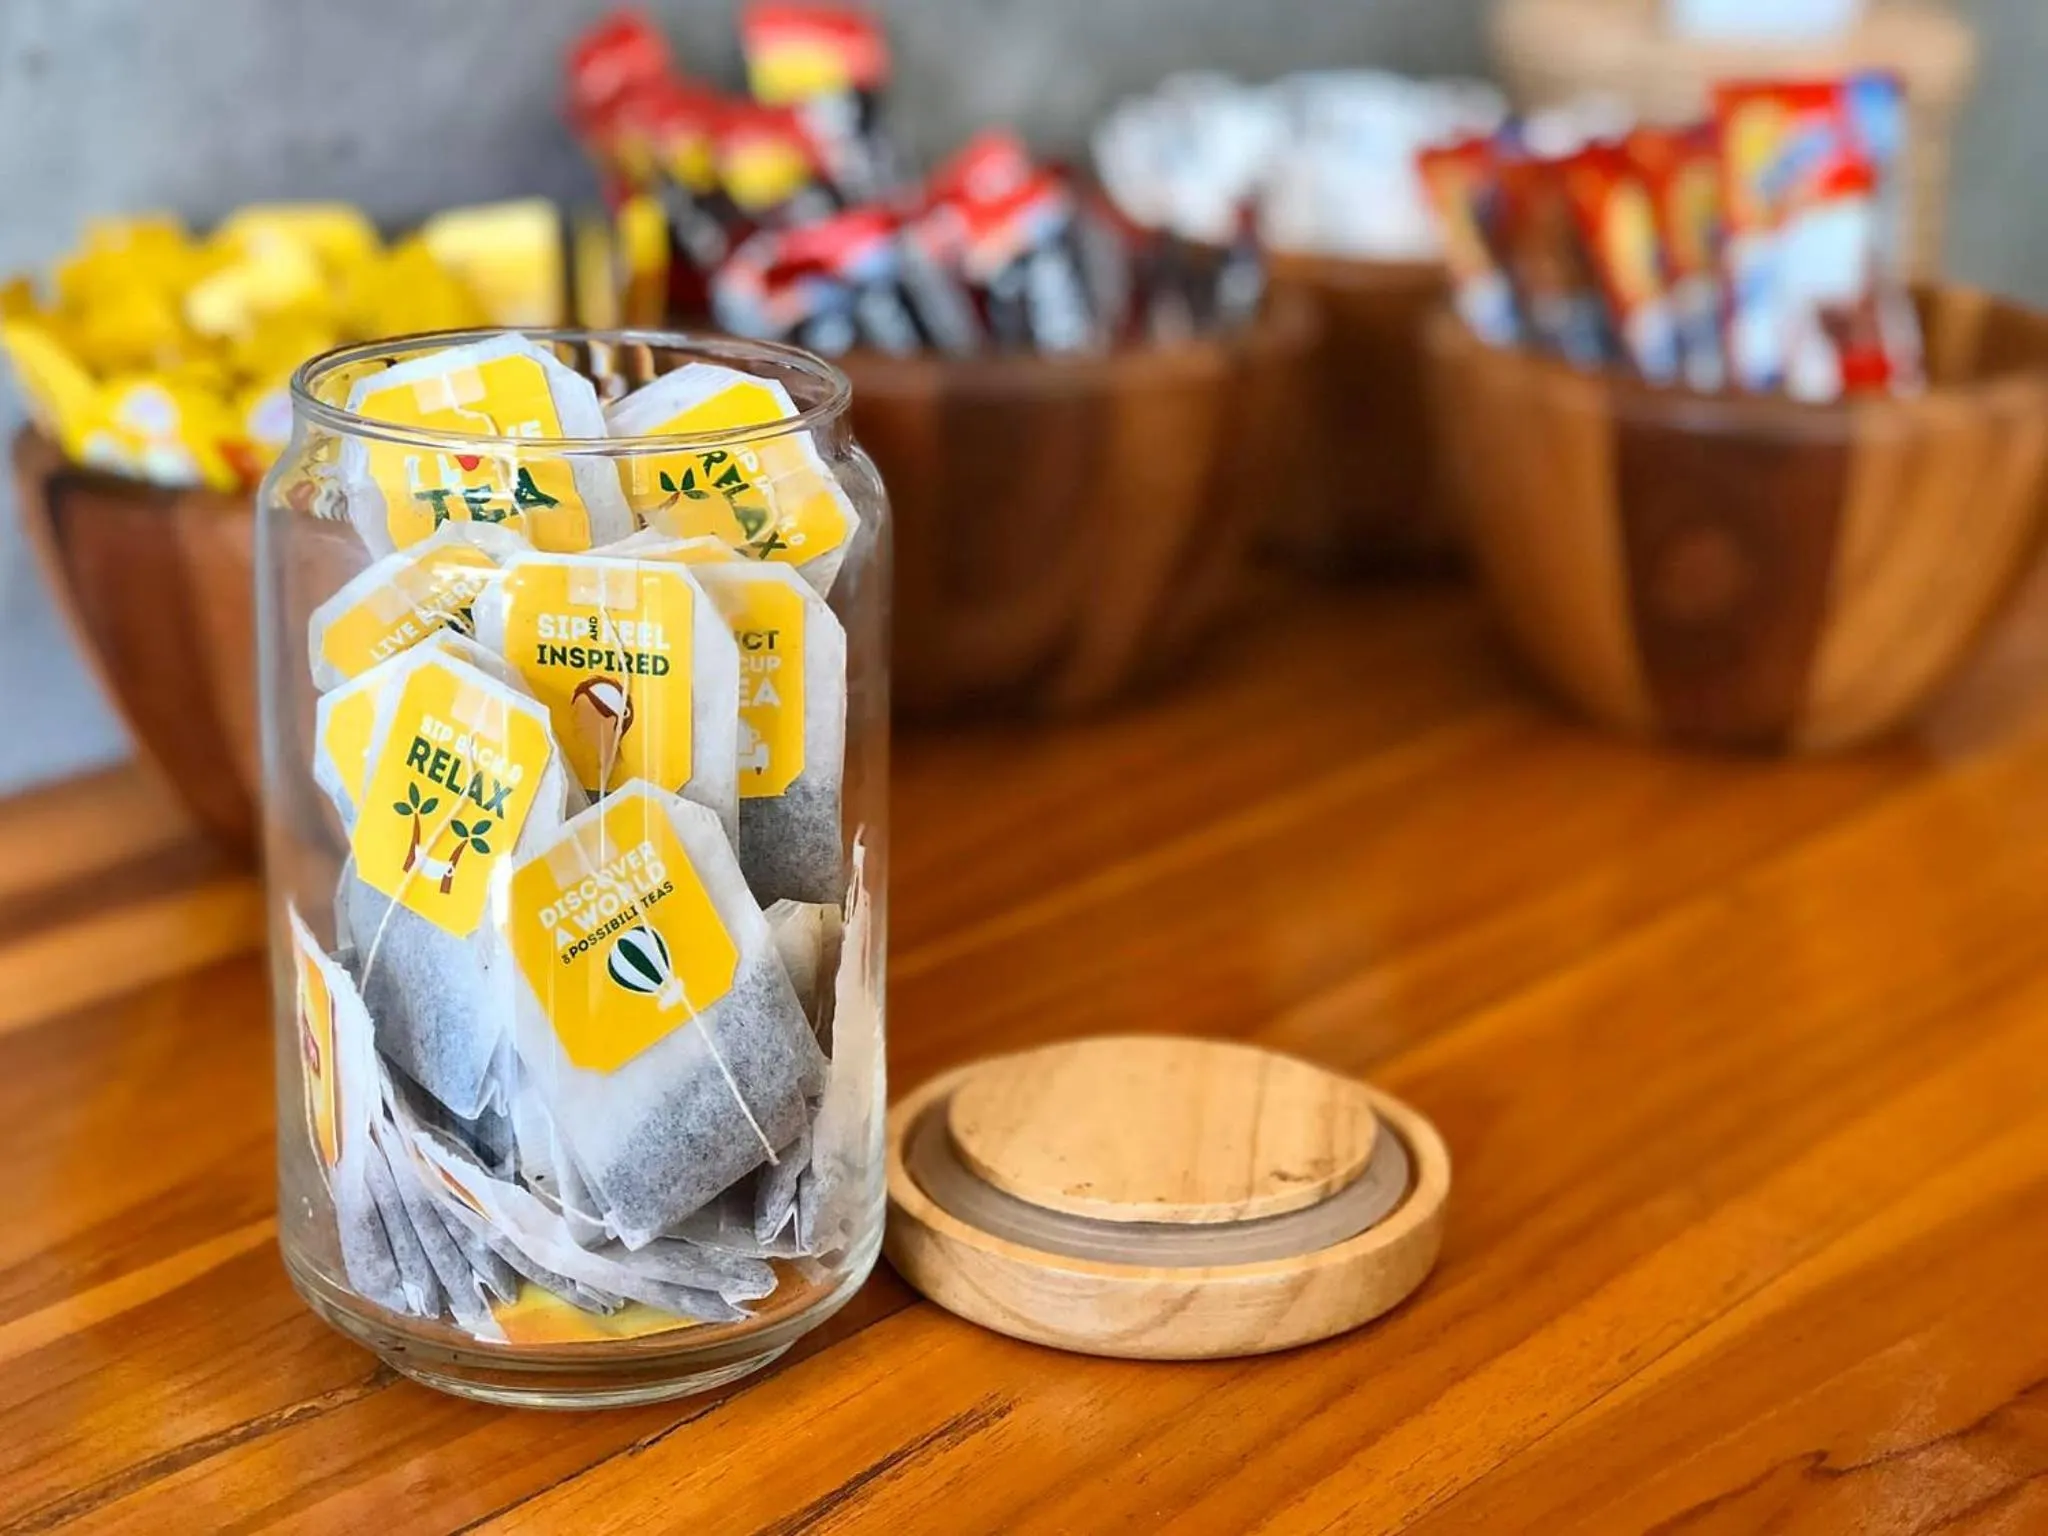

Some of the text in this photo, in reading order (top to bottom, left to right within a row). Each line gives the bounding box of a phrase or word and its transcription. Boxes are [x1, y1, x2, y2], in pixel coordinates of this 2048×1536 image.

[414, 466, 561, 531] TEA
[369, 620, 420, 661] LIVE
[537, 613, 588, 642] SIP
[589, 615, 598, 641] AND
[536, 643, 670, 676] INSPIRED
[420, 714, 454, 742] SIP
[405, 735, 514, 820] RELAX
[537, 840, 657, 930] DISCOVER
[554, 860, 667, 951] A WORLD
